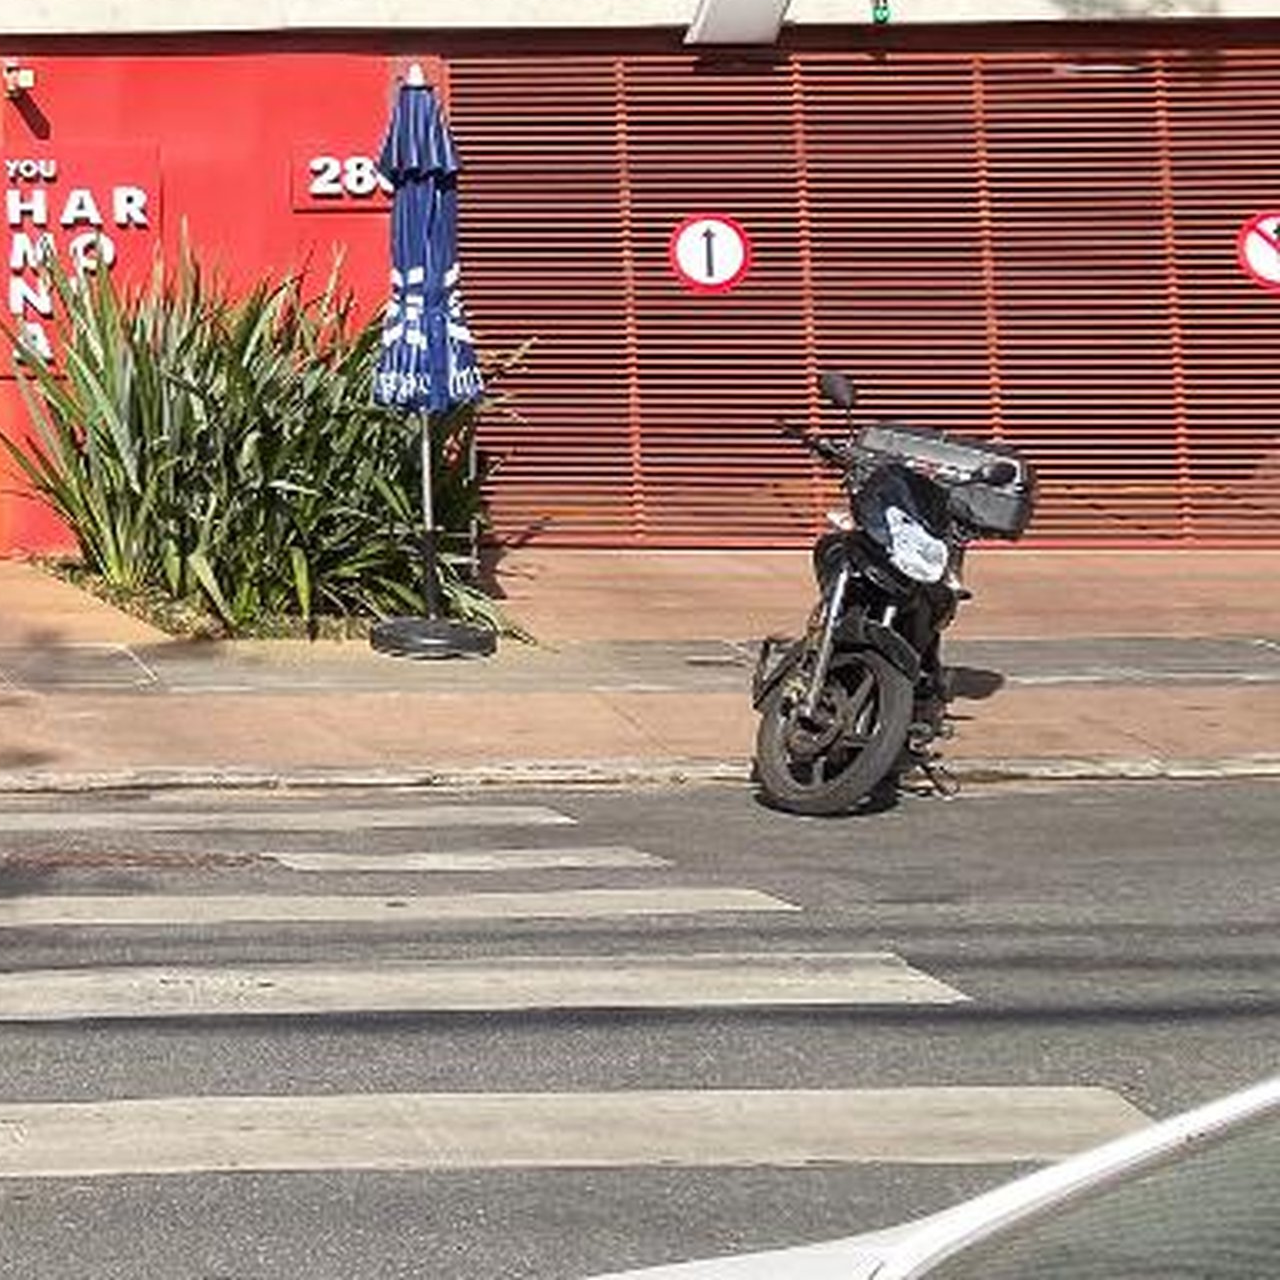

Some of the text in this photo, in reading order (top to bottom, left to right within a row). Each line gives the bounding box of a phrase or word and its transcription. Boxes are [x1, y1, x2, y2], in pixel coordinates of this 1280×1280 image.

[5, 160, 57, 178] YOU
[308, 156, 394, 194] 28
[7, 186, 148, 224] HAR
[10, 232, 116, 270] MO
